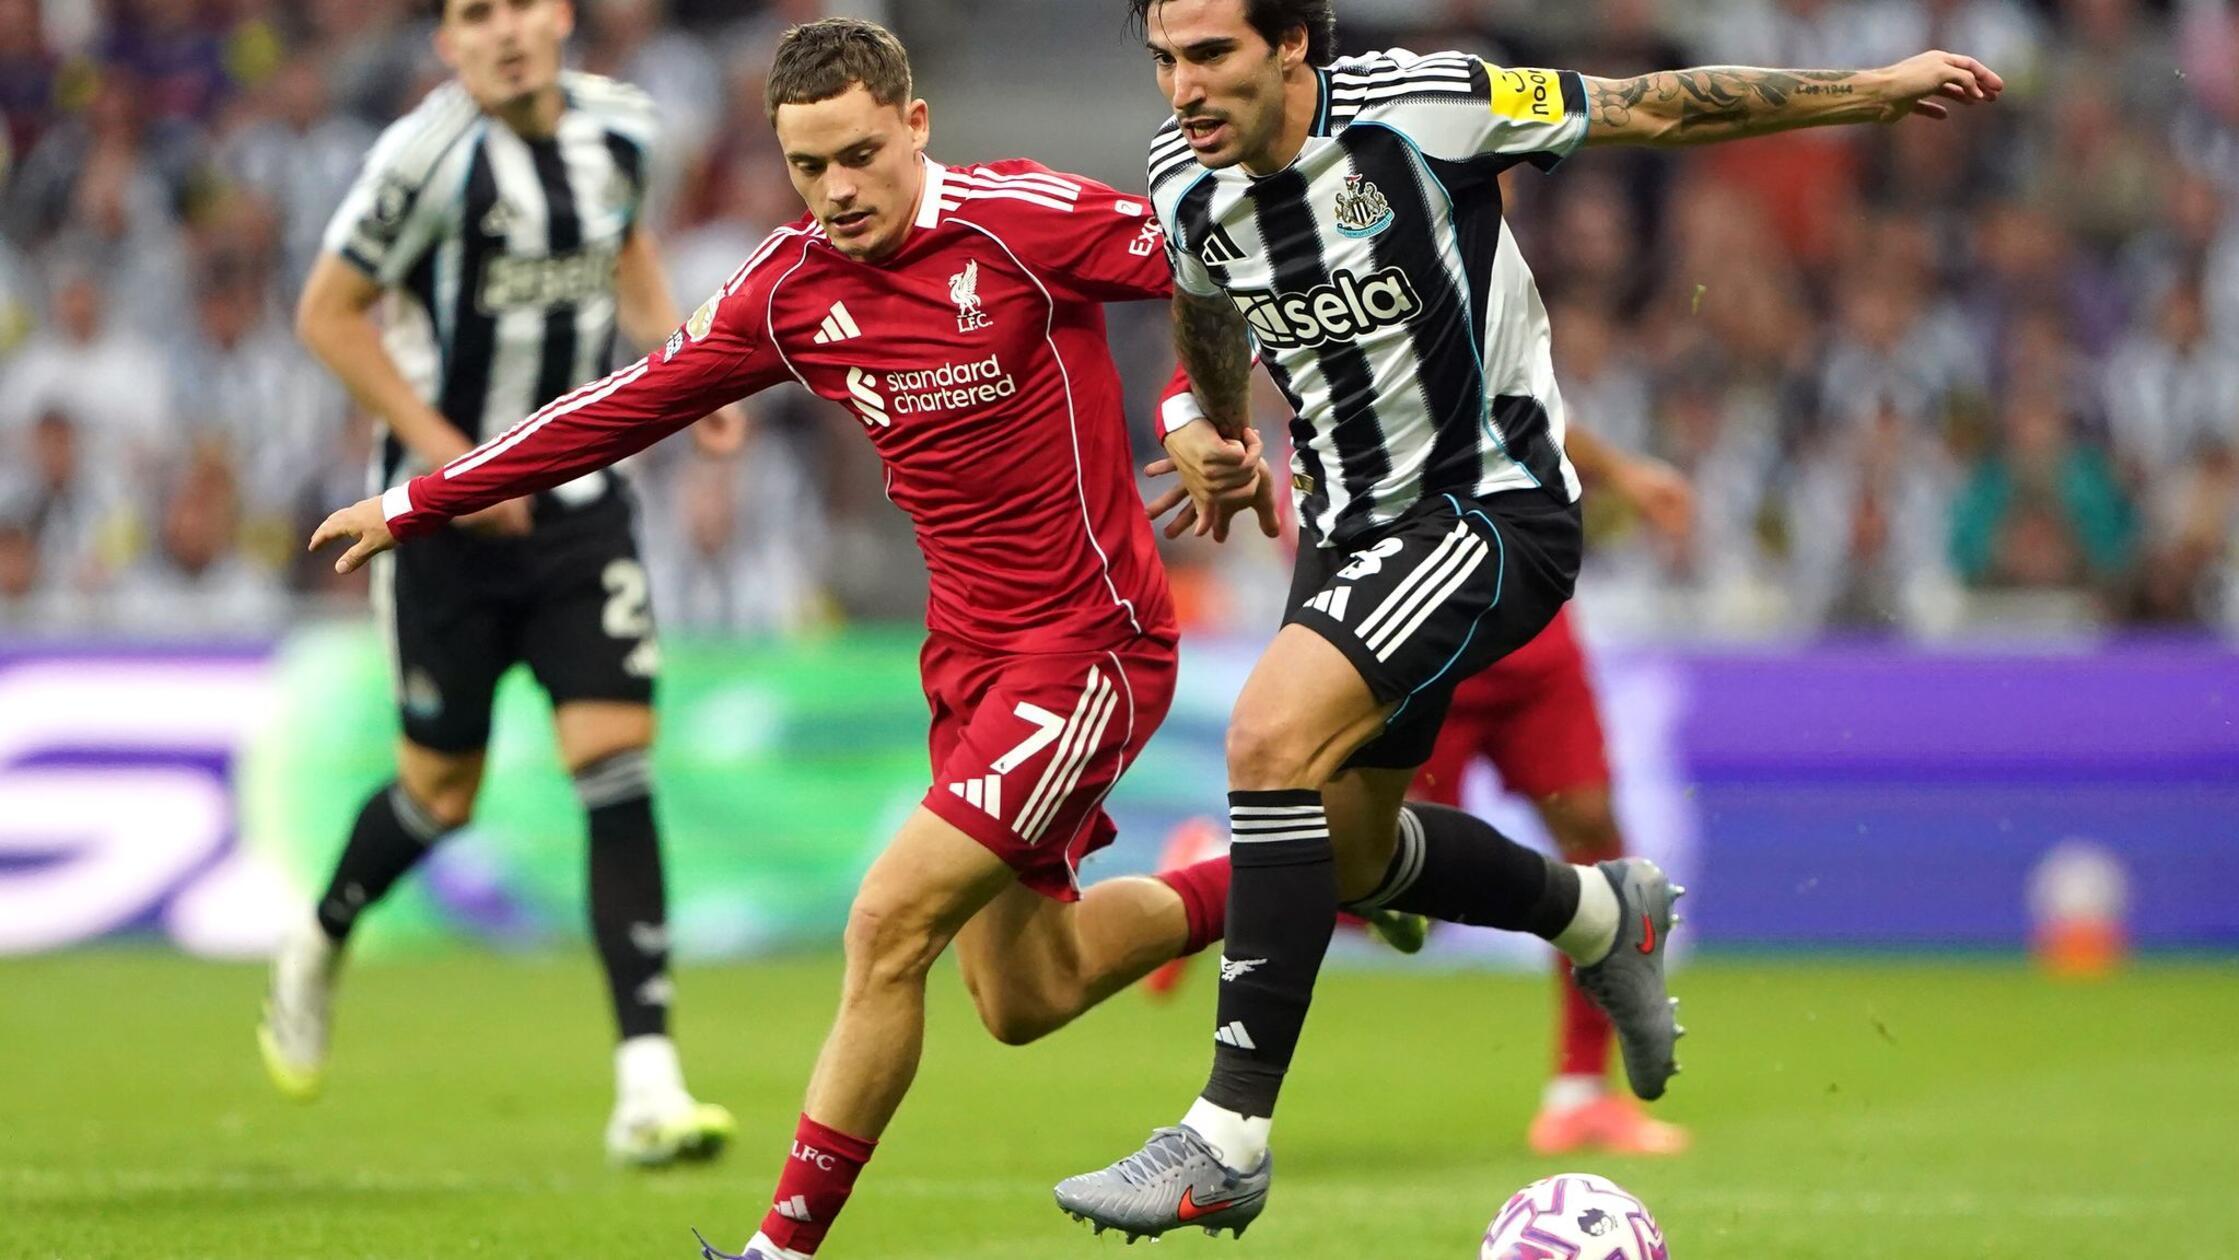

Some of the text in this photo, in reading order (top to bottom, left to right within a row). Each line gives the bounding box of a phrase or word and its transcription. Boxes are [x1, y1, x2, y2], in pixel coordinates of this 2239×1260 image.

[1283, 275, 1413, 340] sela
[886, 353, 1001, 392] standard
[894, 373, 1017, 414] chartered
[990, 701, 1067, 776] 7
[791, 1139, 836, 1172] LFC
